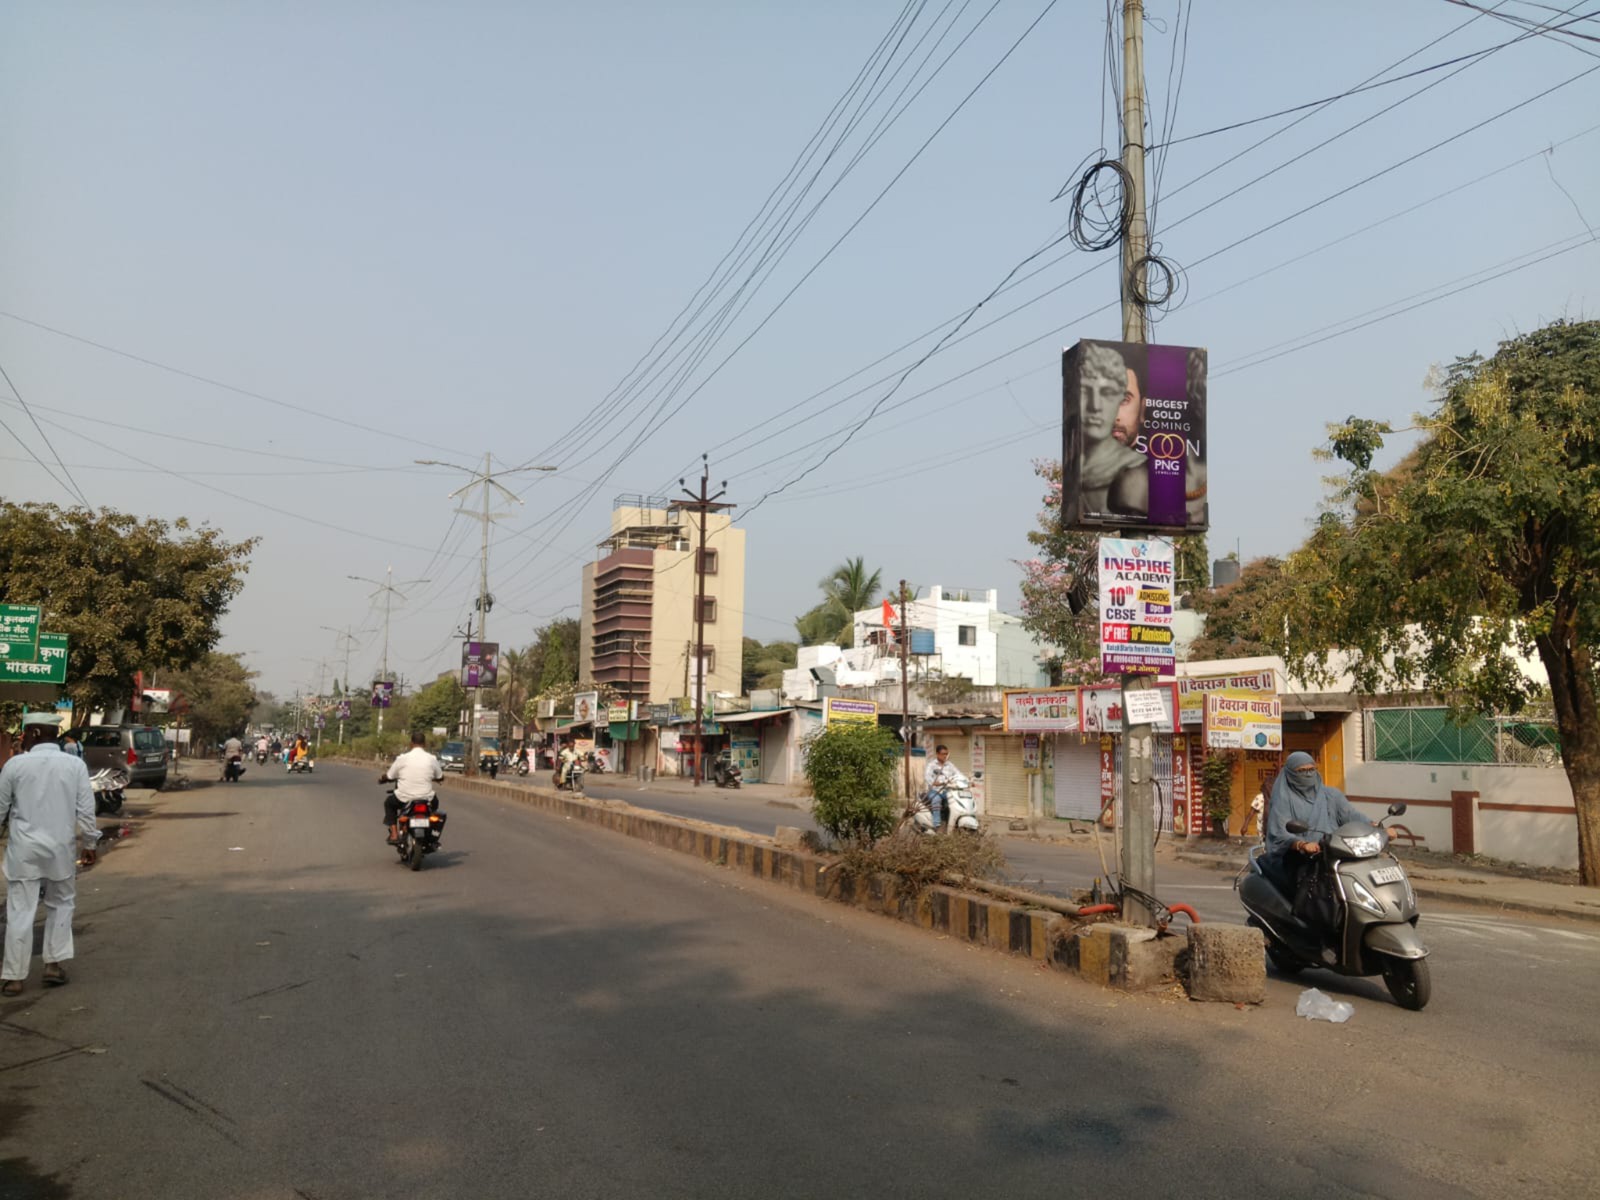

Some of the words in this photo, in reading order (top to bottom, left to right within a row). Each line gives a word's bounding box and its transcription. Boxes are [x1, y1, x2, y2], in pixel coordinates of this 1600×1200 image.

[1145, 399, 1188, 410] BIGGEST
[1153, 411, 1182, 420] GOLD
[1144, 420, 1191, 431] COMING
[1136, 433, 1199, 459] SOON
[1155, 460, 1180, 471] PNG
[1104, 557, 1171, 574] INSPIRE
[1115, 572, 1171, 584] ACADEMY
[1139, 591, 1169, 602] ADMISSIONS
[1106, 608, 1136, 621] CBSE
[1113, 627, 1129, 641] FREE
[1141, 627, 1171, 643] Admission
[40, 647, 65, 662] कृपा
[1189, 678, 1226, 691] देवराज
[1230, 675, 1261, 690] वास्तु
[1219, 696, 1248, 713] देवराज
[1251, 700, 1272, 717] वास्तु
